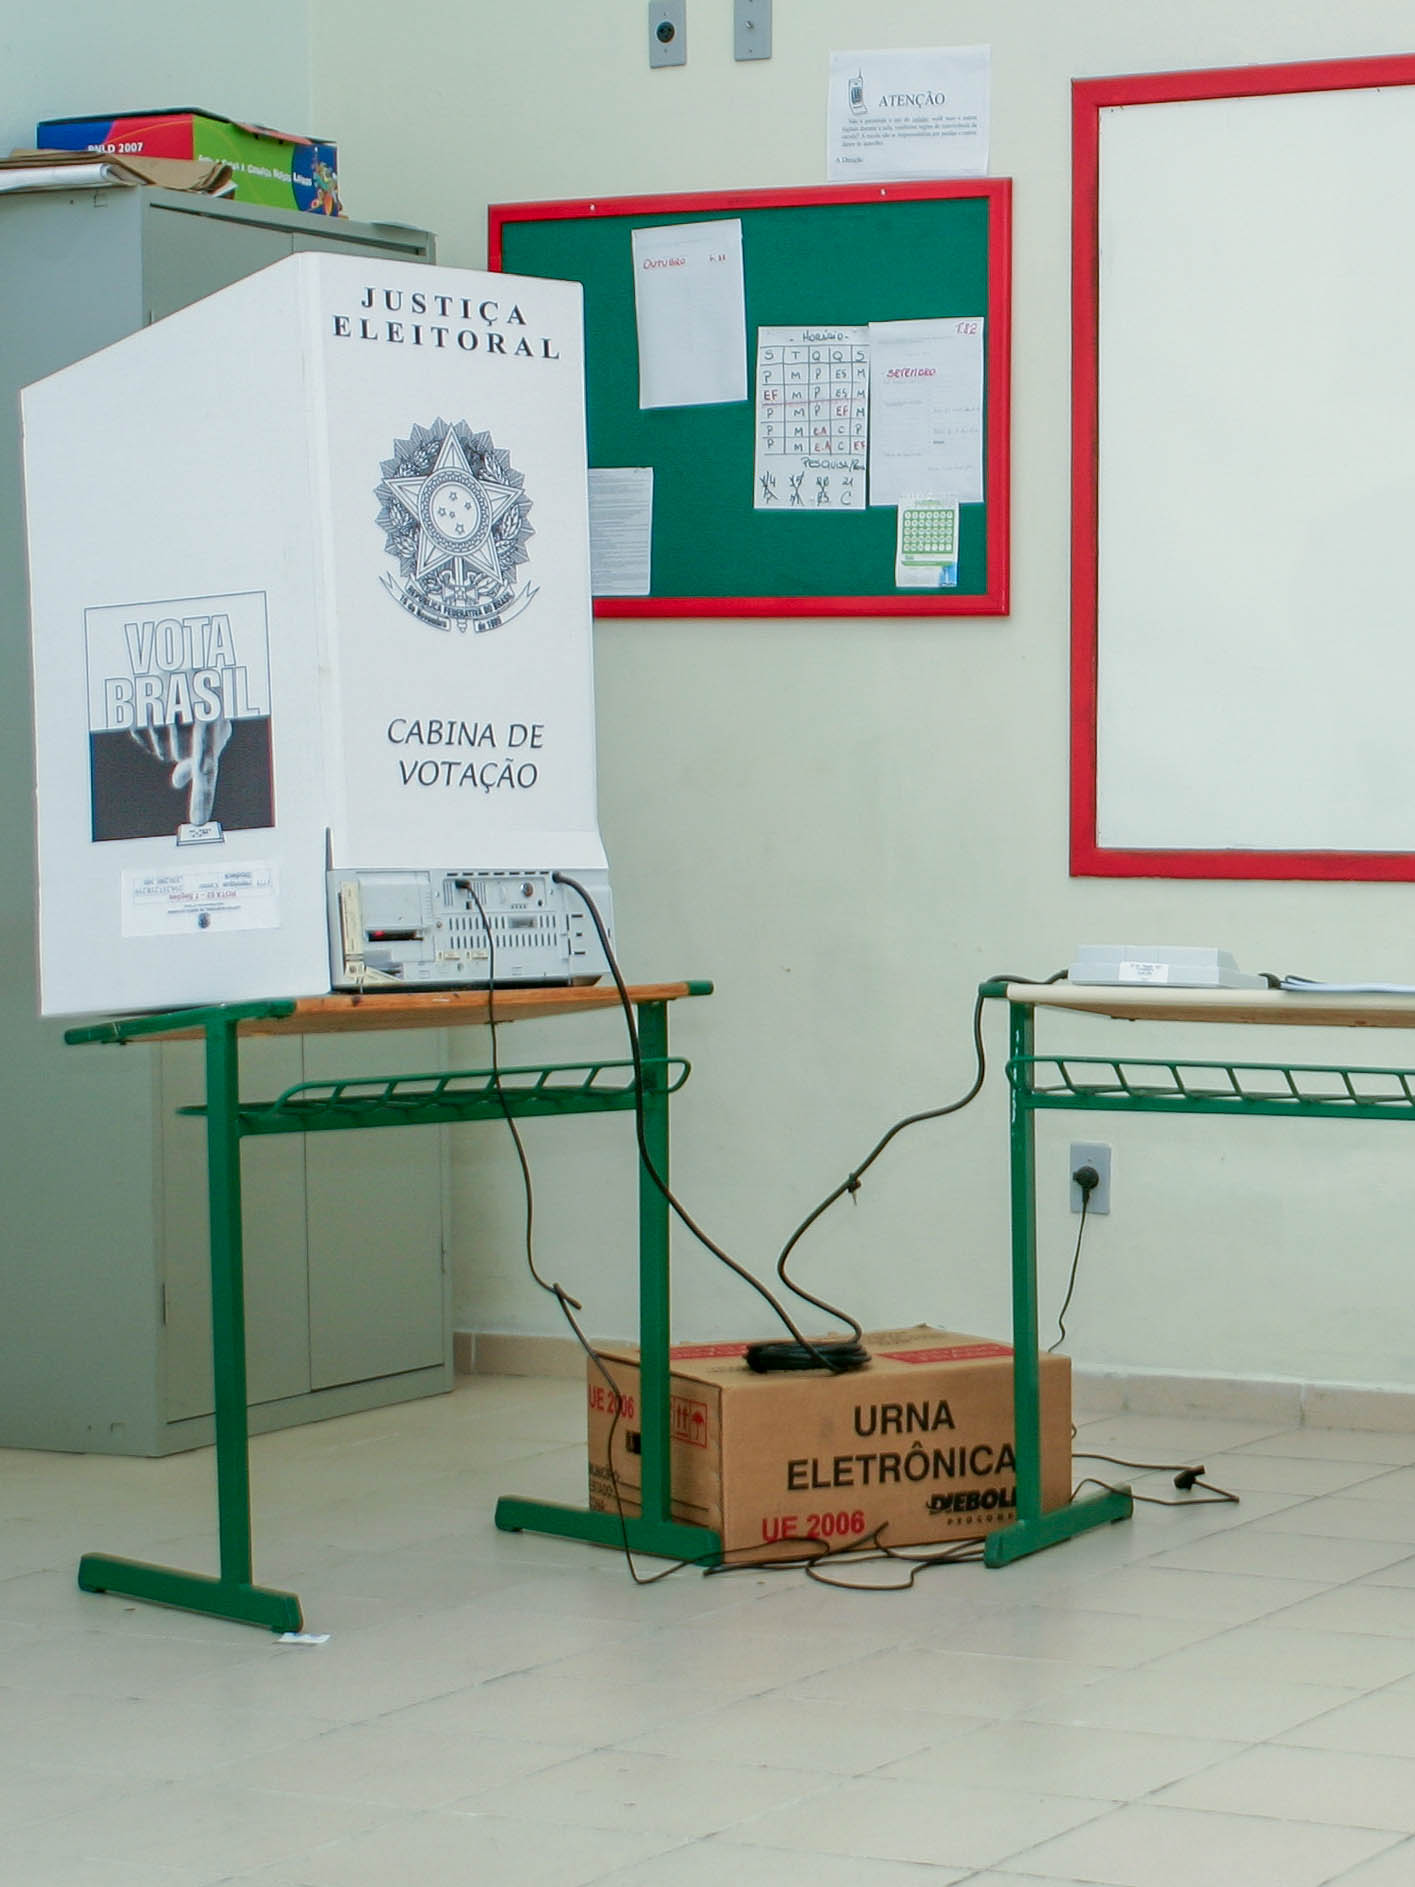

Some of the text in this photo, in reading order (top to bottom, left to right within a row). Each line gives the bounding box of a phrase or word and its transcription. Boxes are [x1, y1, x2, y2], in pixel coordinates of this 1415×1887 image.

[878, 90, 945, 108] ATENÇÃO
[119, 142, 144, 153] 2007
[361, 286, 527, 326] JUSTIÇA
[332, 314, 560, 360] ELEITORAL
[764, 350, 865, 361] S T Q Q S
[763, 389, 778, 401] EF
[124, 613, 237, 675] VOTA
[104, 666, 261, 729] BRASIL
[387, 718, 545, 749] CABINA DE
[399, 757, 538, 794] VOTAÇÃO
[589, 1384, 604, 1411] UE
[854, 1400, 955, 1437] URNA
[787, 1441, 1016, 1490] ELETRÔNICA
[762, 1509, 865, 1543] UE 2006
